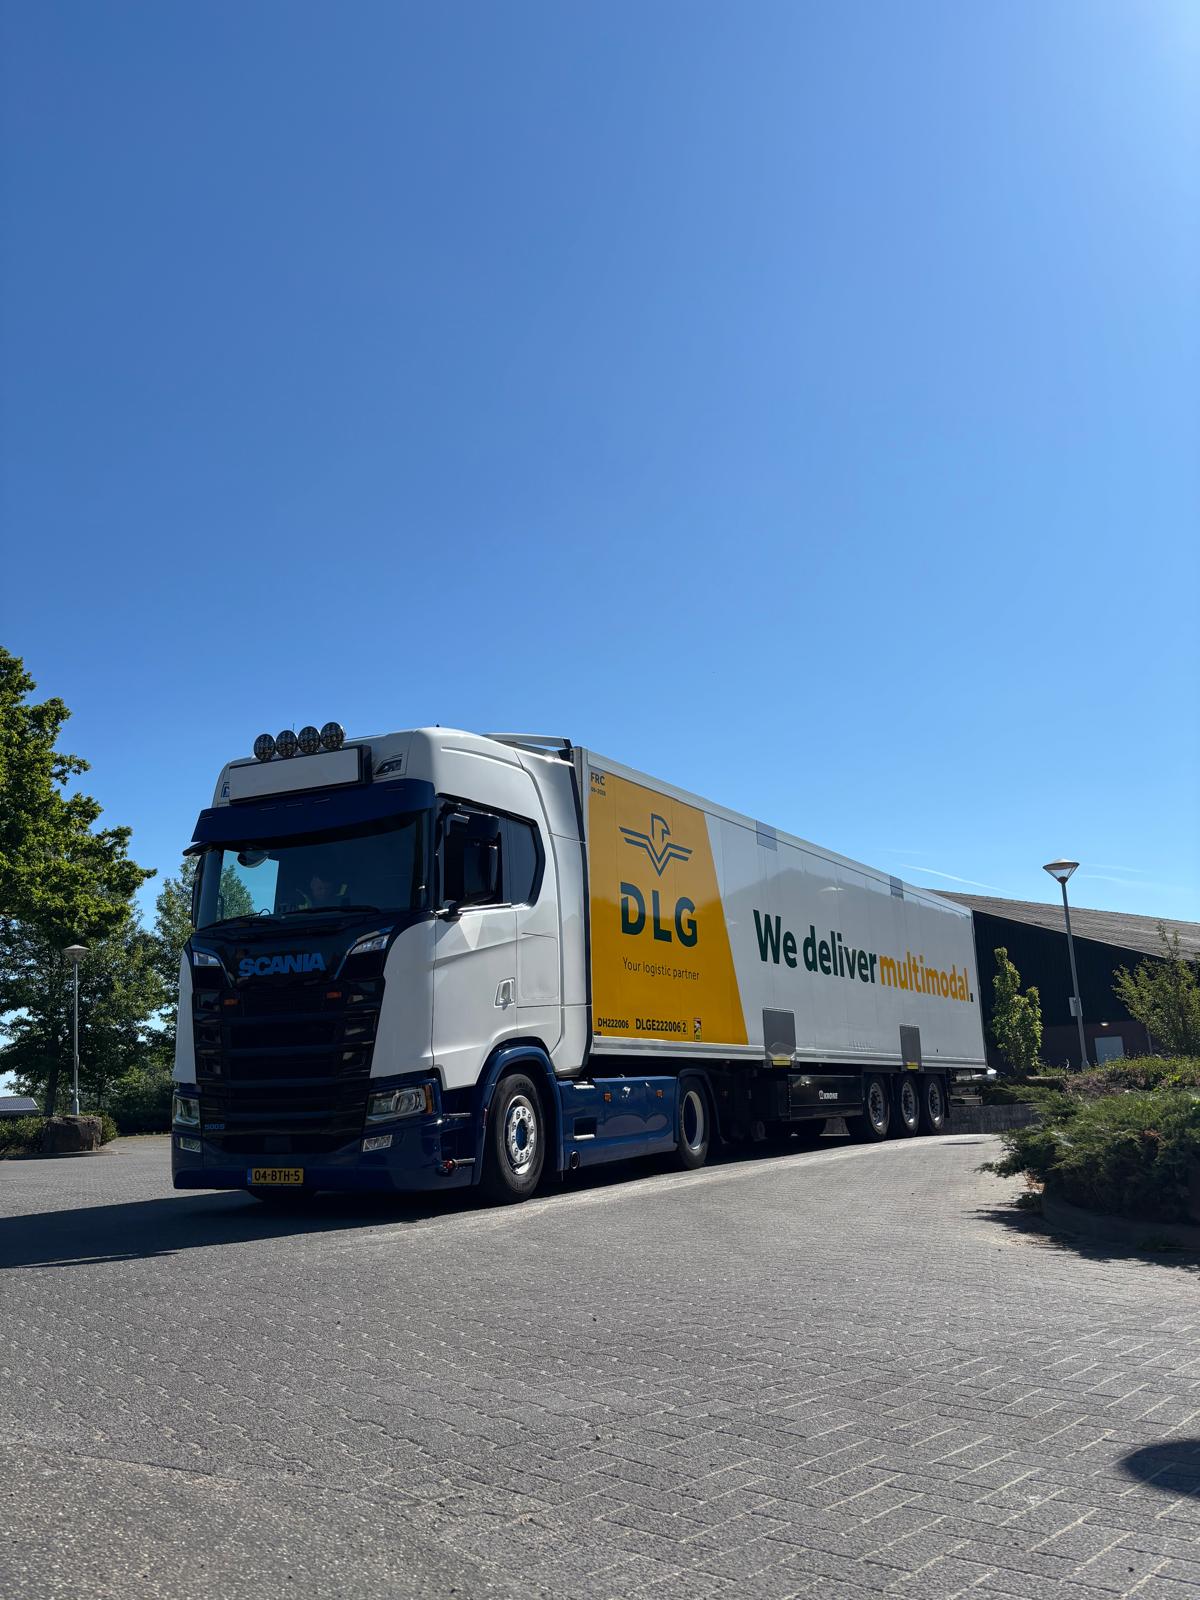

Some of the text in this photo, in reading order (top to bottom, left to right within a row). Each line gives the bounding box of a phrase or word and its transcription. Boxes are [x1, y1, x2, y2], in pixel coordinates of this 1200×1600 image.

[591, 772, 605, 786] FRC
[620, 881, 698, 948] DLG
[238, 952, 327, 977] SCANIA
[622, 956, 700, 981] Your logistic partner
[753, 909, 974, 1003] We deliver multimodal.
[597, 1017, 629, 1029] DH222006
[635, 1018, 681, 1033] DLGE222006
[254, 1169, 300, 1182] 04-BTH-5
